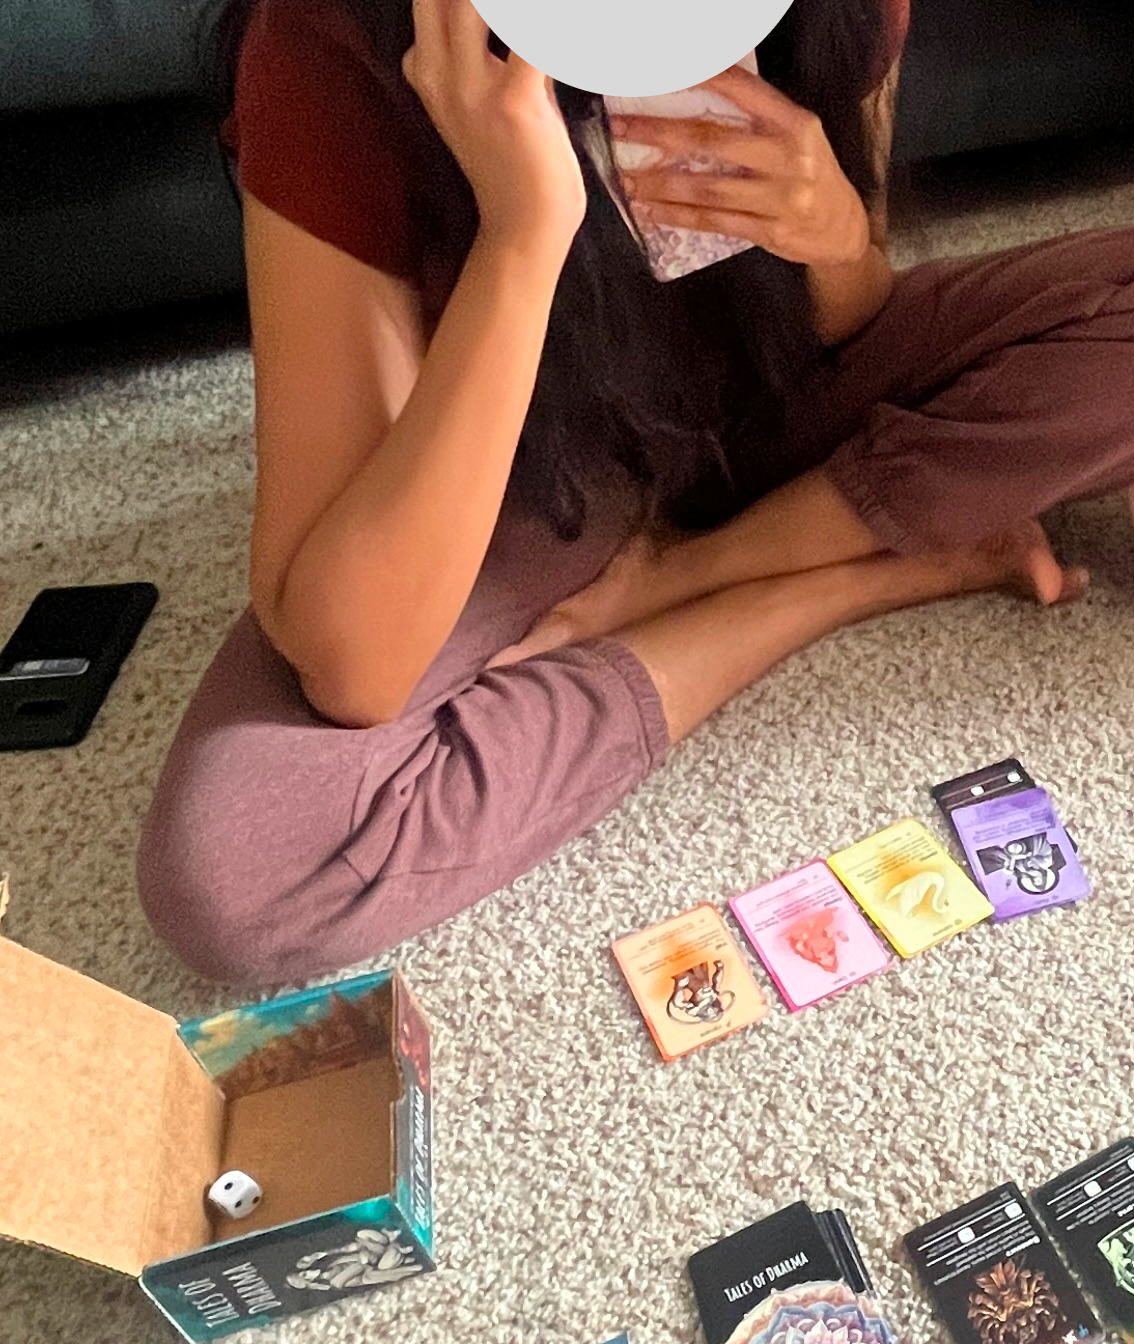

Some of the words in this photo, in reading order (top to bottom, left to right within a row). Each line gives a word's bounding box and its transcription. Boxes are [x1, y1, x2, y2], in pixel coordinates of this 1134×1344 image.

[178, 1276, 216, 1296] OF
[222, 1260, 281, 1314] DHARMA
[724, 1280, 752, 1302] TALES
[753, 1272, 766, 1288] OF
[765, 1252, 808, 1281] DHARMA
[192, 1290, 239, 1327] TALES
